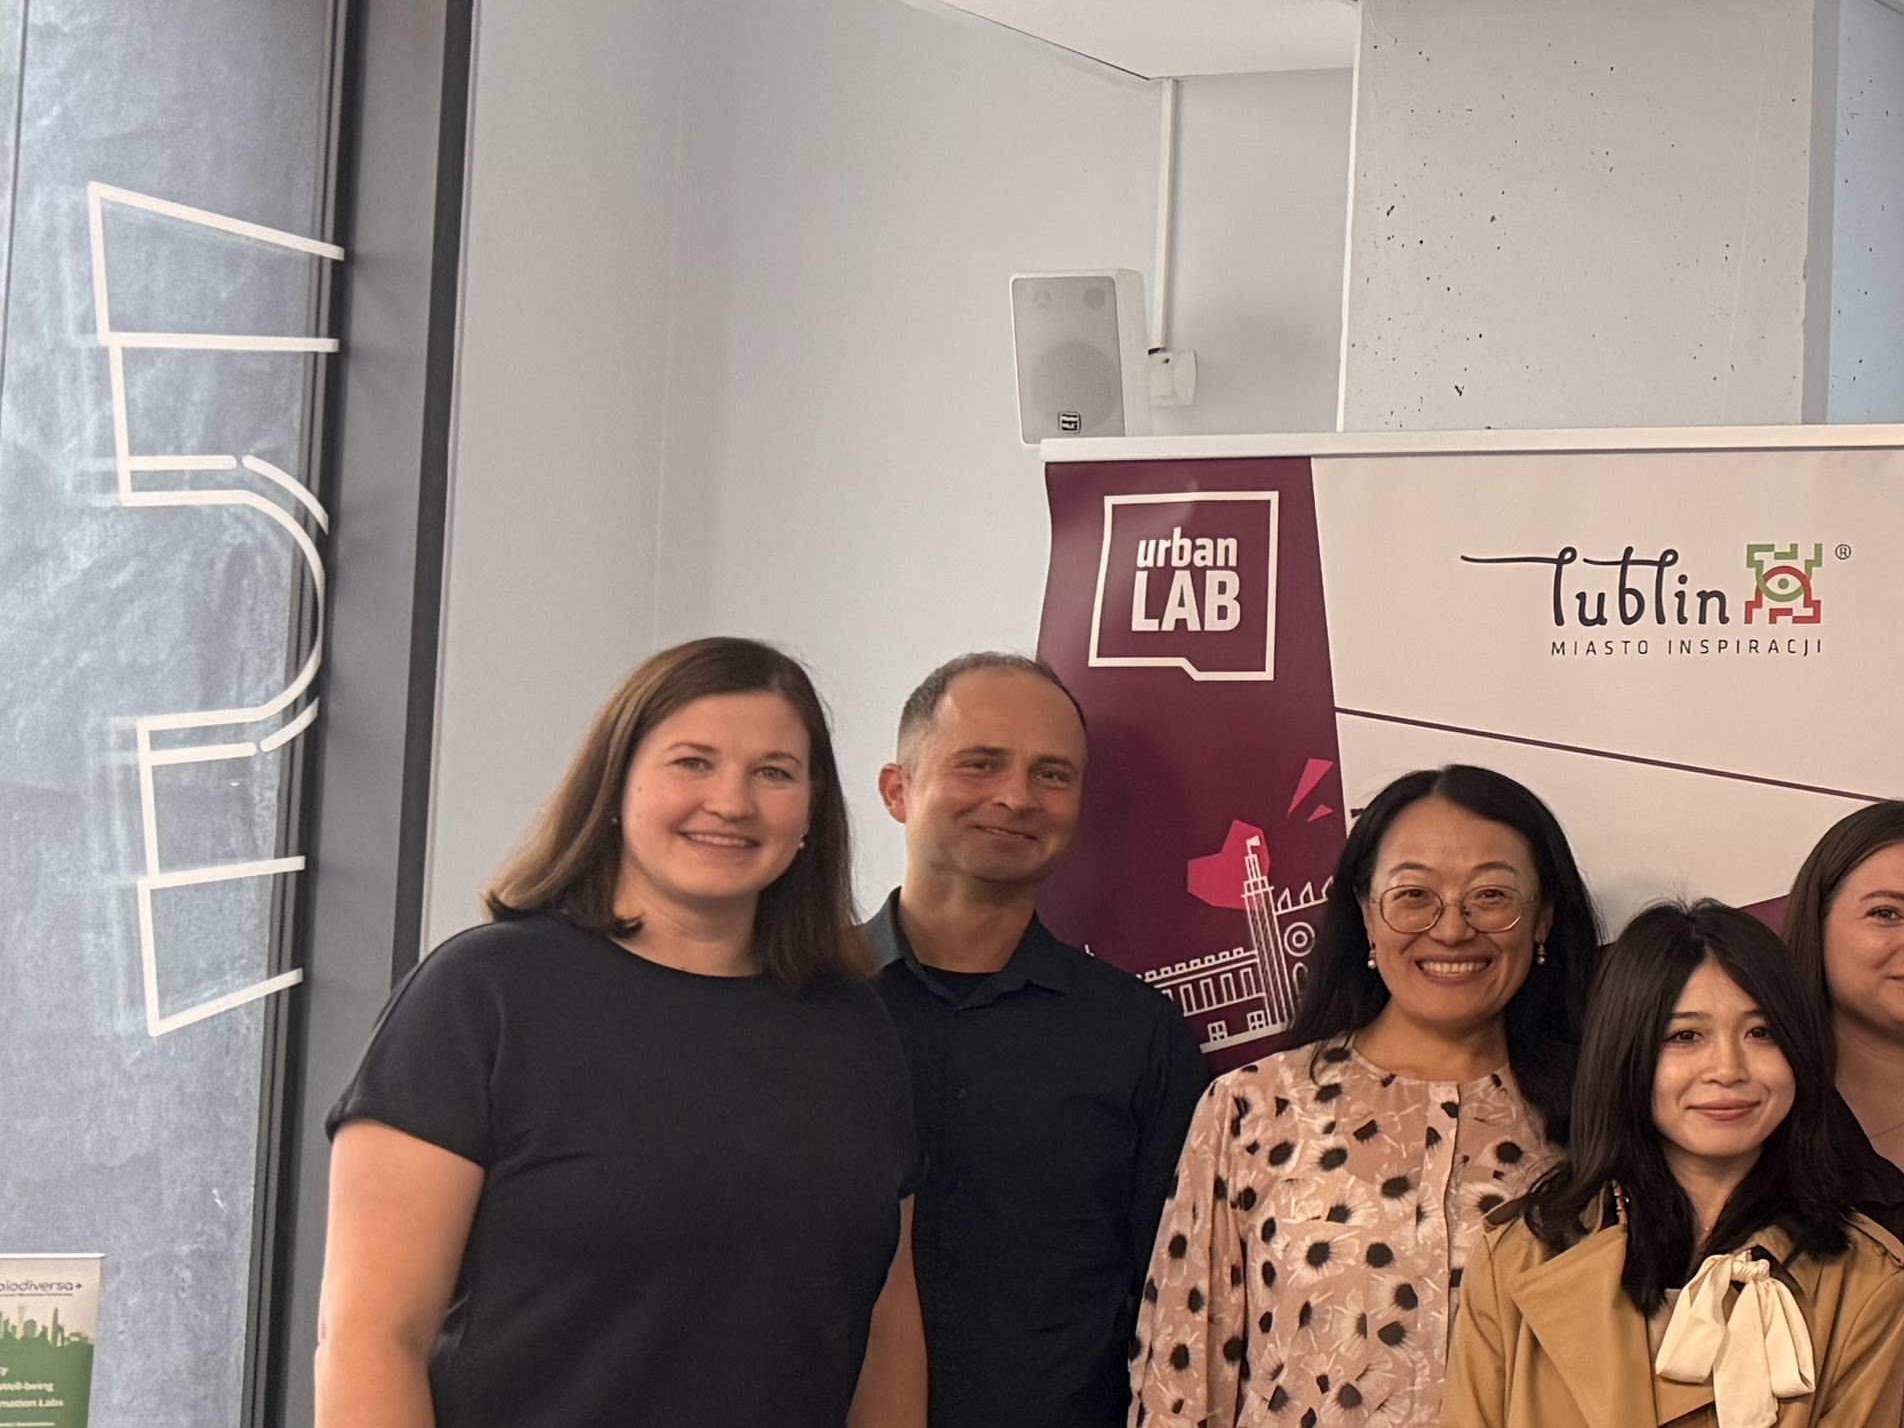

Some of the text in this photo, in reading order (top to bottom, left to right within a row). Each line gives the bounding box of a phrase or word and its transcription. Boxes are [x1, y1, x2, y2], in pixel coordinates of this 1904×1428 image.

[1135, 526, 1238, 570] urban
[1130, 570, 1242, 634] LAB
[1461, 546, 1731, 628] lublin
[1551, 637, 1824, 658] MIASTO INSPIRACJI
